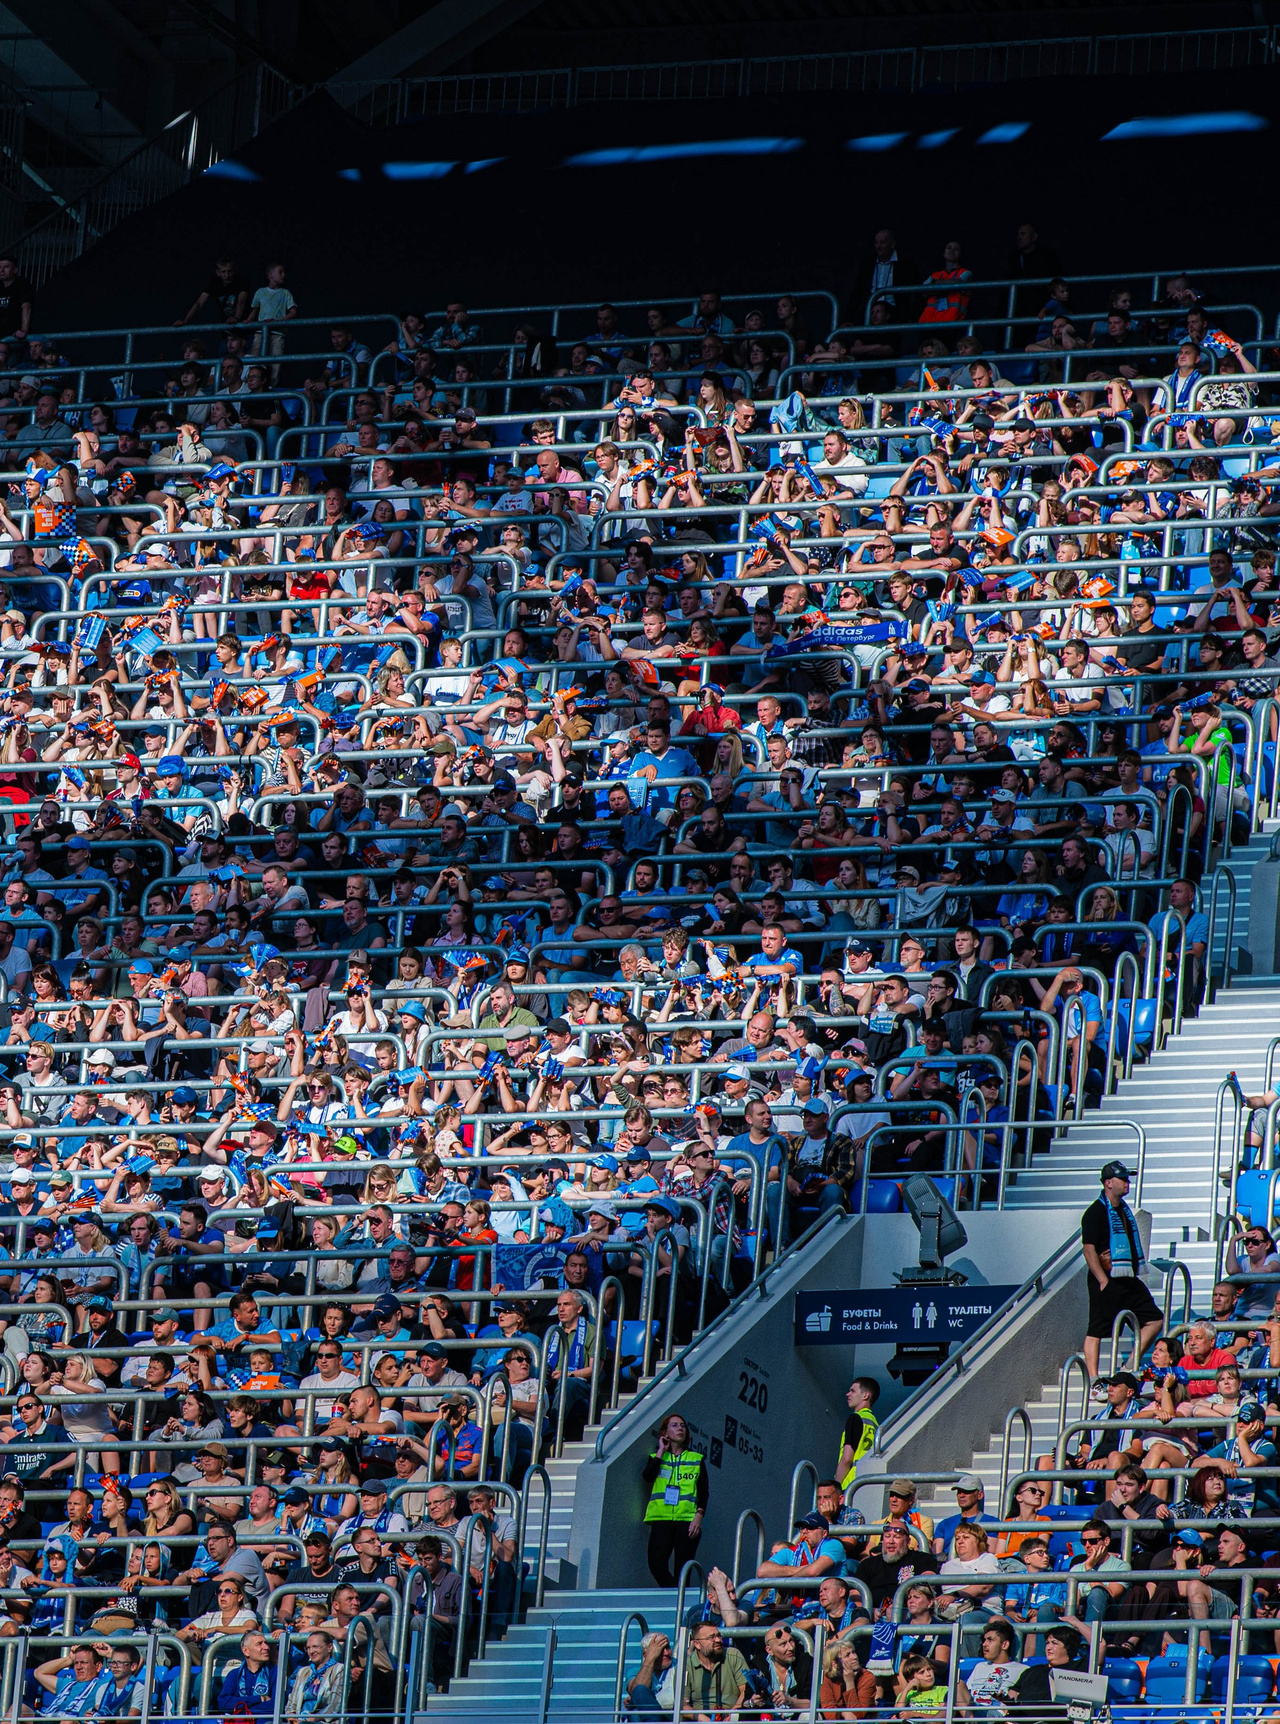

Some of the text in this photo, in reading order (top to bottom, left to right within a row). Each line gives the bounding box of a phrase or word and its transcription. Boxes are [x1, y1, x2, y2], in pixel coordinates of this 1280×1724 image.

[812, 627, 864, 637] adidas
[836, 634, 875, 644] Петербург
[842, 1306, 992, 1318] БУФЕТЫ ТУАЛЕТЫ
[842, 1319, 963, 1331] Food & Drinks WC
[744, 1357, 758, 1372] СЕКТОР
[738, 1372, 768, 1414] 220
[740, 1423, 752, 1436] РЯДЫ
[738, 1437, 763, 1463] 05-33
[678, 1472, 699, 1480] 3407
[1058, 1675, 1094, 1684] PANOMERA
